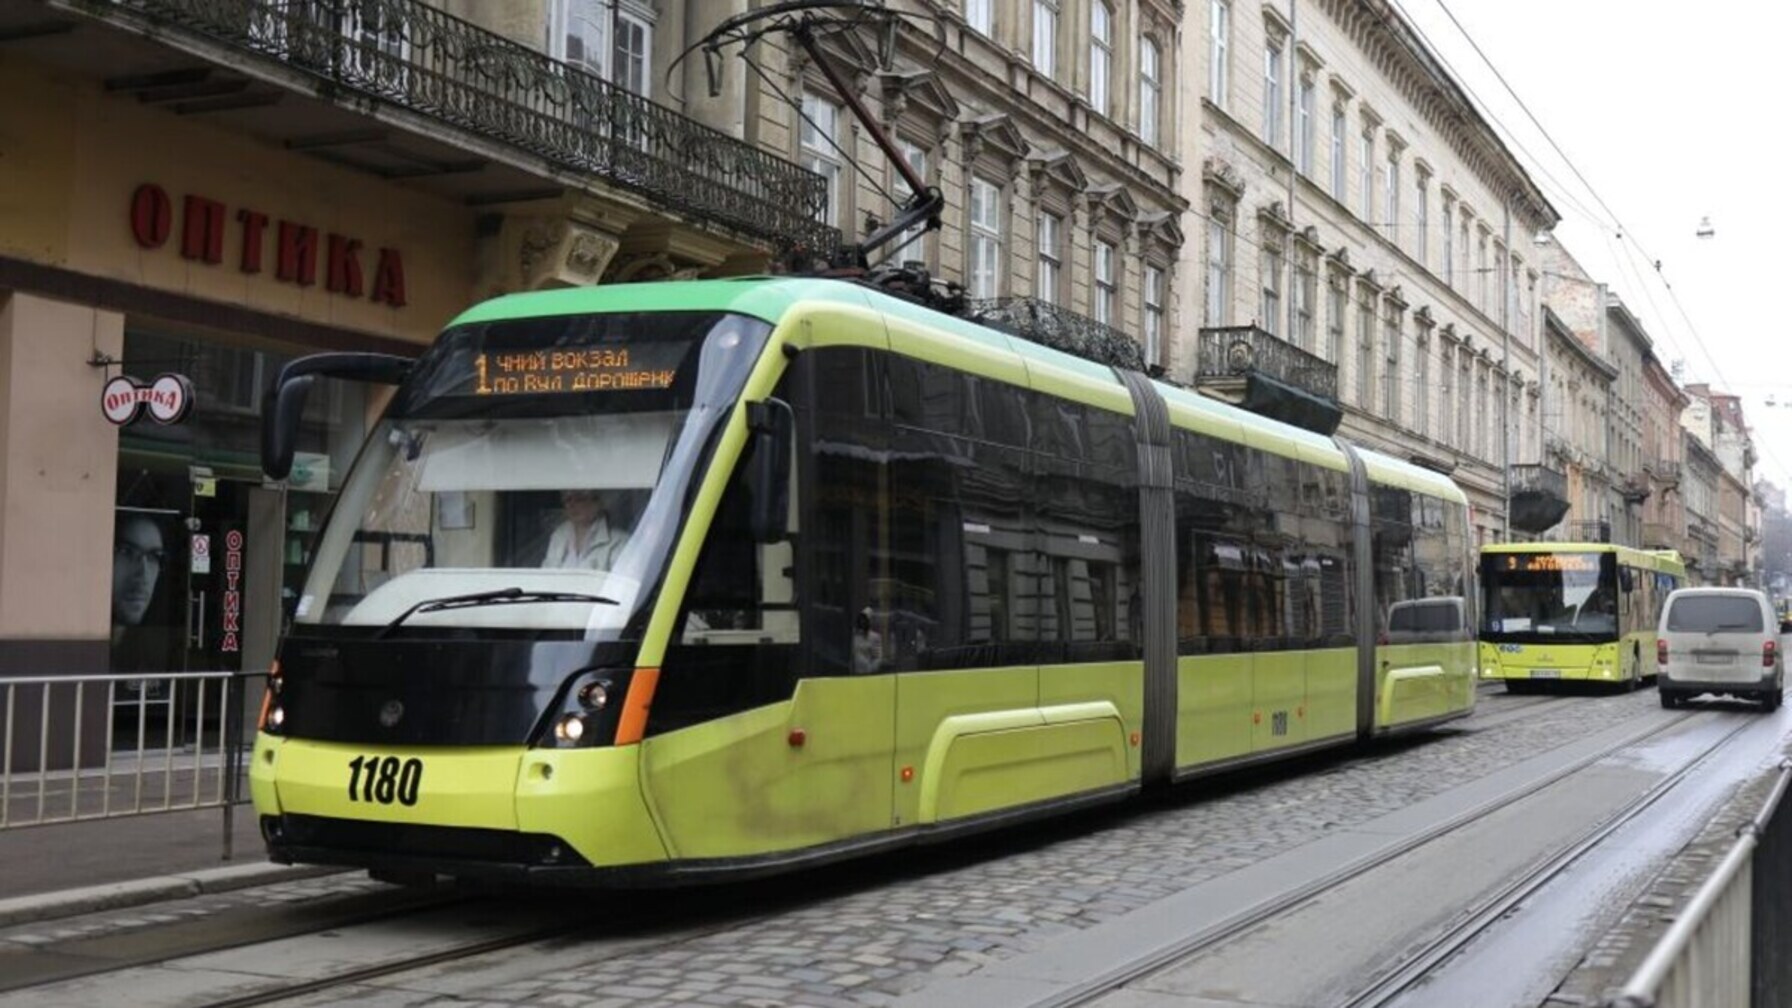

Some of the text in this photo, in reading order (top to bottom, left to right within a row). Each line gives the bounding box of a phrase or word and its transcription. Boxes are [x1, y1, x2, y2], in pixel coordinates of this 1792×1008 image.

[130, 182, 407, 308] ОПТИКА
[474, 354, 492, 394] 1
[222, 530, 242, 651] ОПТИКА
[348, 755, 423, 807] 1180
